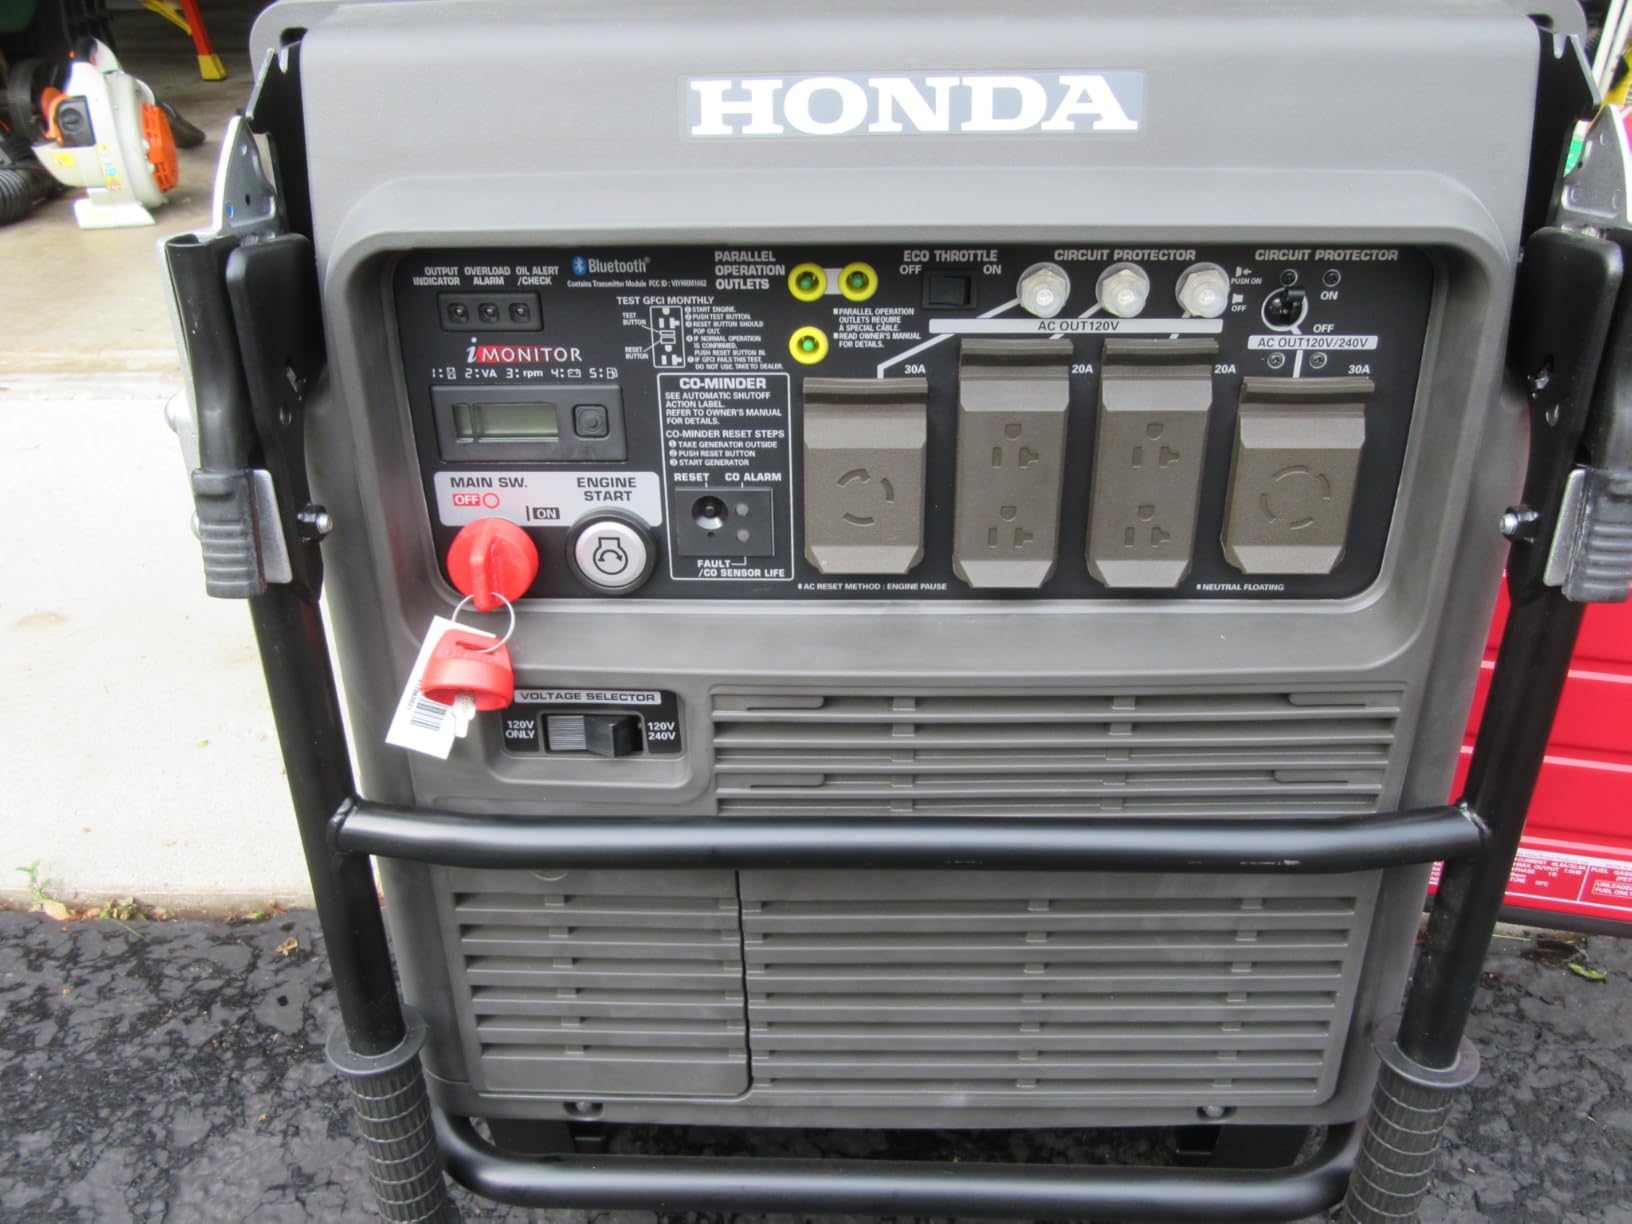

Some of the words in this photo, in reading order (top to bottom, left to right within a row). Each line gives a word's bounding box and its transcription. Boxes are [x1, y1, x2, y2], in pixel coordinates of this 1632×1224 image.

[690, 75, 1138, 136] HONDA
[715, 251, 776, 262] PARALLEL
[903, 250, 929, 262] ECO
[933, 250, 998, 262] THROTTLE
[1054, 249, 1110, 261] CIRCUIT
[1113, 249, 1196, 261] PROTECTOR
[1255, 249, 1311, 261] CIRCUIT
[1314, 249, 1399, 261] PROTECTOR
[424, 266, 459, 276] OUTPUT
[464, 266, 511, 276] OVERLOAD
[515, 266, 530, 276] OIL
[532, 266, 559, 276] ALERT
[715, 265, 785, 276] OPERATION
[900, 265, 922, 275] OFF
[983, 265, 1002, 275] ON
[413, 276, 460, 286] INDICATOR
[473, 276, 505, 286] ALARM
[517, 276, 552, 286] /CHECK
[567, 280, 592, 288] Contains
[592, 280, 625, 288] Transmitter
[625, 280, 647, 288] Module
[648, 280, 660, 288] FCC
[716, 278, 770, 290] OUTLETS
[1320, 290, 1338, 300] ON
[616, 296, 640, 305] TEST
[642, 296, 665, 305] GFCI
[667, 296, 715, 305] MONTHLY
[1231, 304, 1247, 312] OFF
[839, 316, 869, 324] OUTLETS
[871, 316, 901, 324] REQUIRE
[839, 324, 844, 332] A
[846, 324, 874, 332] SPECIAL
[876, 324, 900, 332] CABLE.
[1038, 321, 1056, 331] AC
[1313, 324, 1334, 334] OFF
[1258, 338, 1274, 348] AC
[465, 369, 480, 378] 2:
[482, 369, 498, 378] VA
[506, 369, 519, 378] 3:
[523, 370, 544, 379] rpm
[551, 369, 564, 378] 4:
[904, 365, 926, 374] 30A
[1072, 365, 1094, 374] 20A
[1214, 365, 1236, 374] 20A
[1348, 365, 1370, 374] 30A
[680, 378, 766, 389] CO-MINDER
[665, 392, 680, 400] SEE
[682, 392, 732, 400] AUTOMATIC
[733, 392, 771, 400] SHUTOFF
[666, 430, 721, 438] CO-MINDER
[723, 430, 752, 438] RESET
[754, 430, 784, 438] STEPS
[450, 477, 493, 488] MAIN
[498, 477, 528, 488] SW.
[576, 477, 636, 488] ENGINE
[674, 473, 710, 482] RESET
[725, 473, 741, 482] CO
[744, 473, 782, 482] ALARM
[455, 495, 478, 505] OFF
[584, 491, 632, 501] START
[536, 510, 556, 519] ON
[698, 560, 731, 568] FAULT
[699, 569, 718, 577] /CO
[720, 569, 761, 577] SENSOR
[765, 569, 784, 577] LIFE
[804, 583, 815, 591] AC
[817, 583, 842, 591] RESET
[846, 583, 880, 591] METHOD
[887, 583, 918, 591] ENGINE
[920, 583, 947, 591] PAUSE
[520, 692, 582, 700] VOLTAGE
[586, 692, 655, 702] SELECTOR
[507, 720, 534, 729] 120V
[648, 722, 675, 731] 120V
[505, 730, 535, 739] ONLY
[648, 731, 676, 740] 240V
